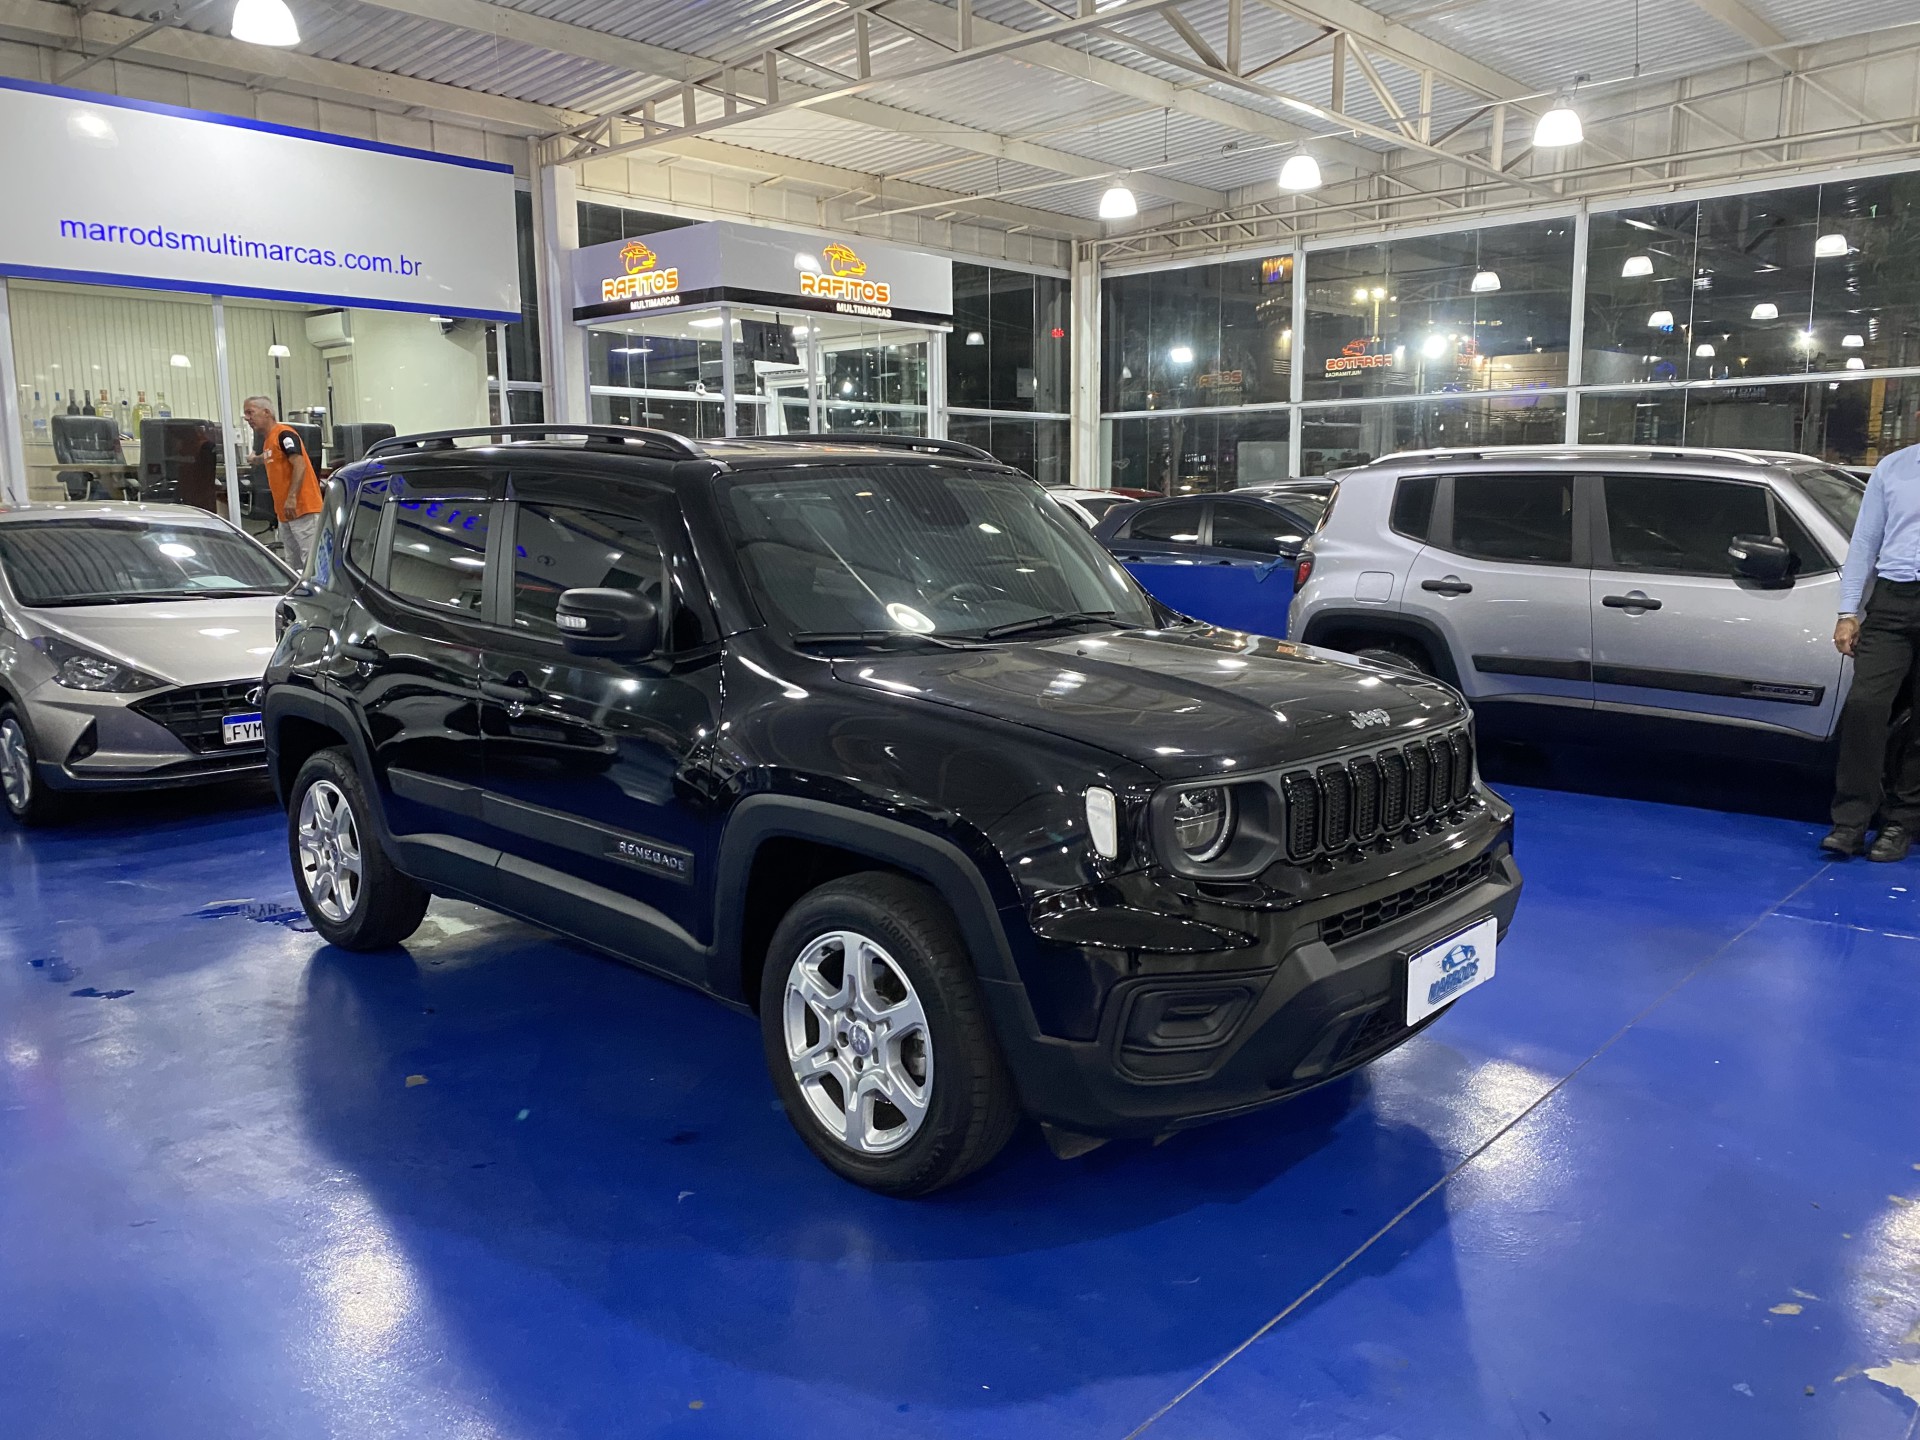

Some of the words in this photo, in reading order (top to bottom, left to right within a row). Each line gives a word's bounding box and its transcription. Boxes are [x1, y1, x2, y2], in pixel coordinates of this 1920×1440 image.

[60, 218, 422, 277] marrodsmultimarcas.com.br
[602, 267, 678, 301] RAFITOS
[800, 271, 891, 304] RAFITOS
[630, 295, 680, 310] MULTIMARCAS
[836, 302, 892, 318] MULTIMARCAS
[232, 723, 262, 741] FYM
[1348, 708, 1391, 730] Jeep
[619, 841, 686, 871] RENEGADE
